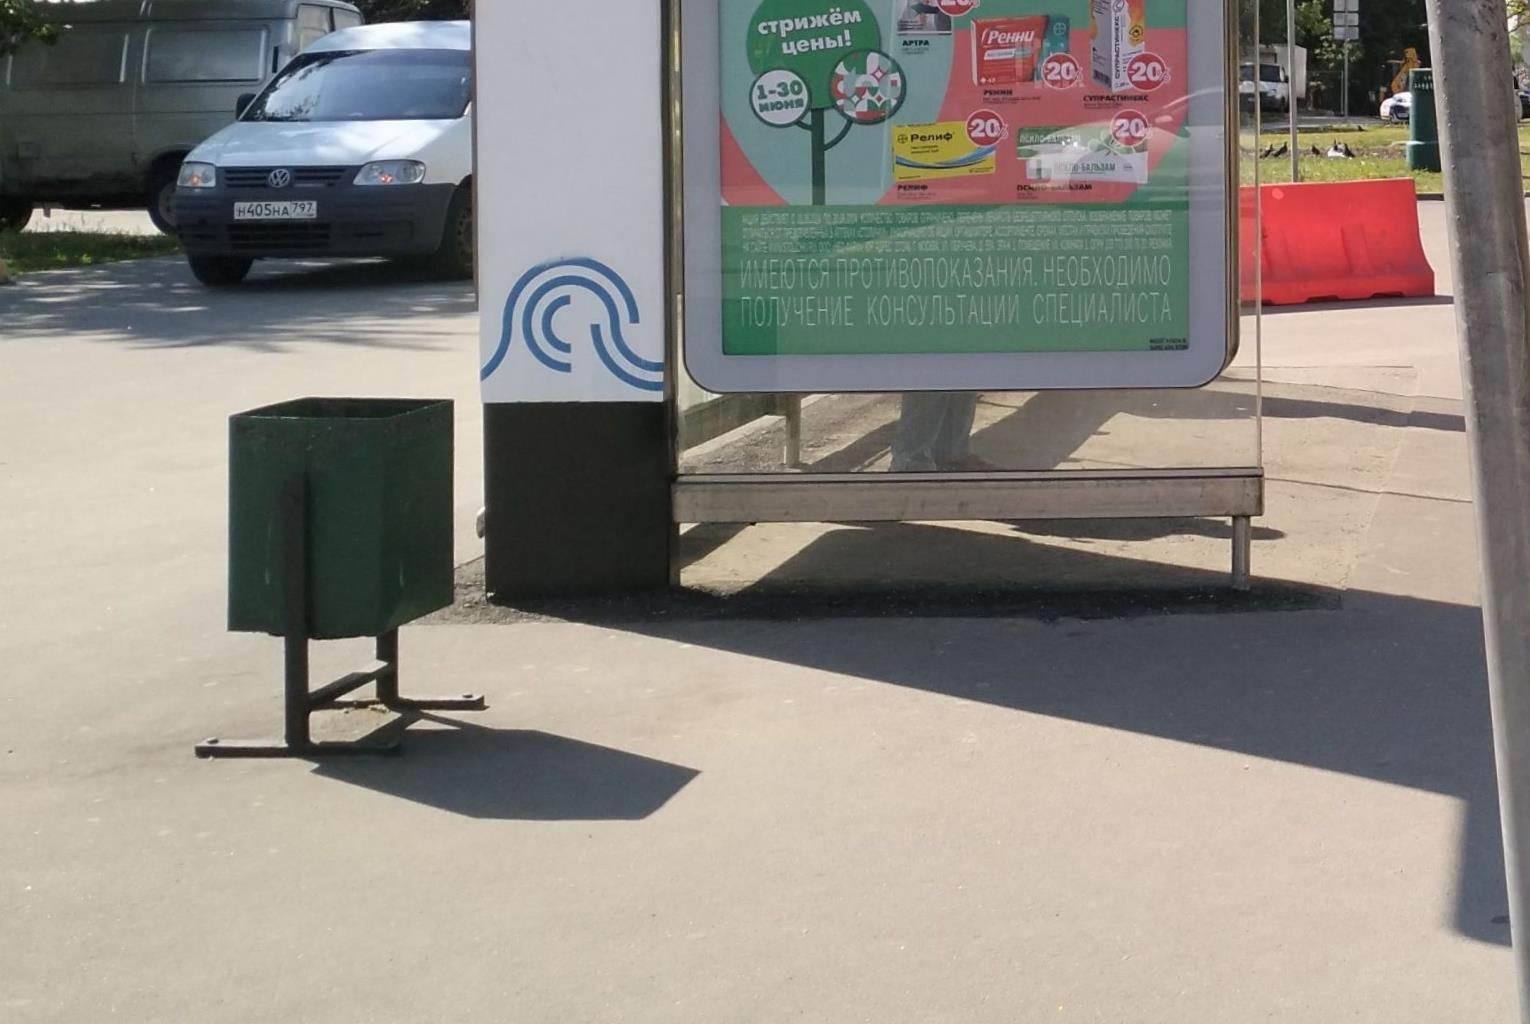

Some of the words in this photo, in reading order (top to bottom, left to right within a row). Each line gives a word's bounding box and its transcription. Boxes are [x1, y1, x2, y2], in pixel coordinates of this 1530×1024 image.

[757, 7, 862, 37] стрижём
[781, 29, 853, 55] цены!
[902, 39, 930, 47] АРТРА
[987, 30, 1036, 45] Ренни
[756, 79, 804, 100] 1-30
[910, 130, 953, 143] Релиф
[740, 258, 830, 290] ИМЕЮТСЯ
[835, 256, 1039, 289] ПРОТИВОПОКАЗАНИЯ.
[1043, 255, 1171, 289] НЕОБХОДИМО
[740, 295, 854, 327] ПОЛУЧЕНИЕ
[866, 293, 1020, 327] КОНСУЛЬТАЦИИ
[1032, 291, 1172, 327] СПЕЦИАЛИСТА
